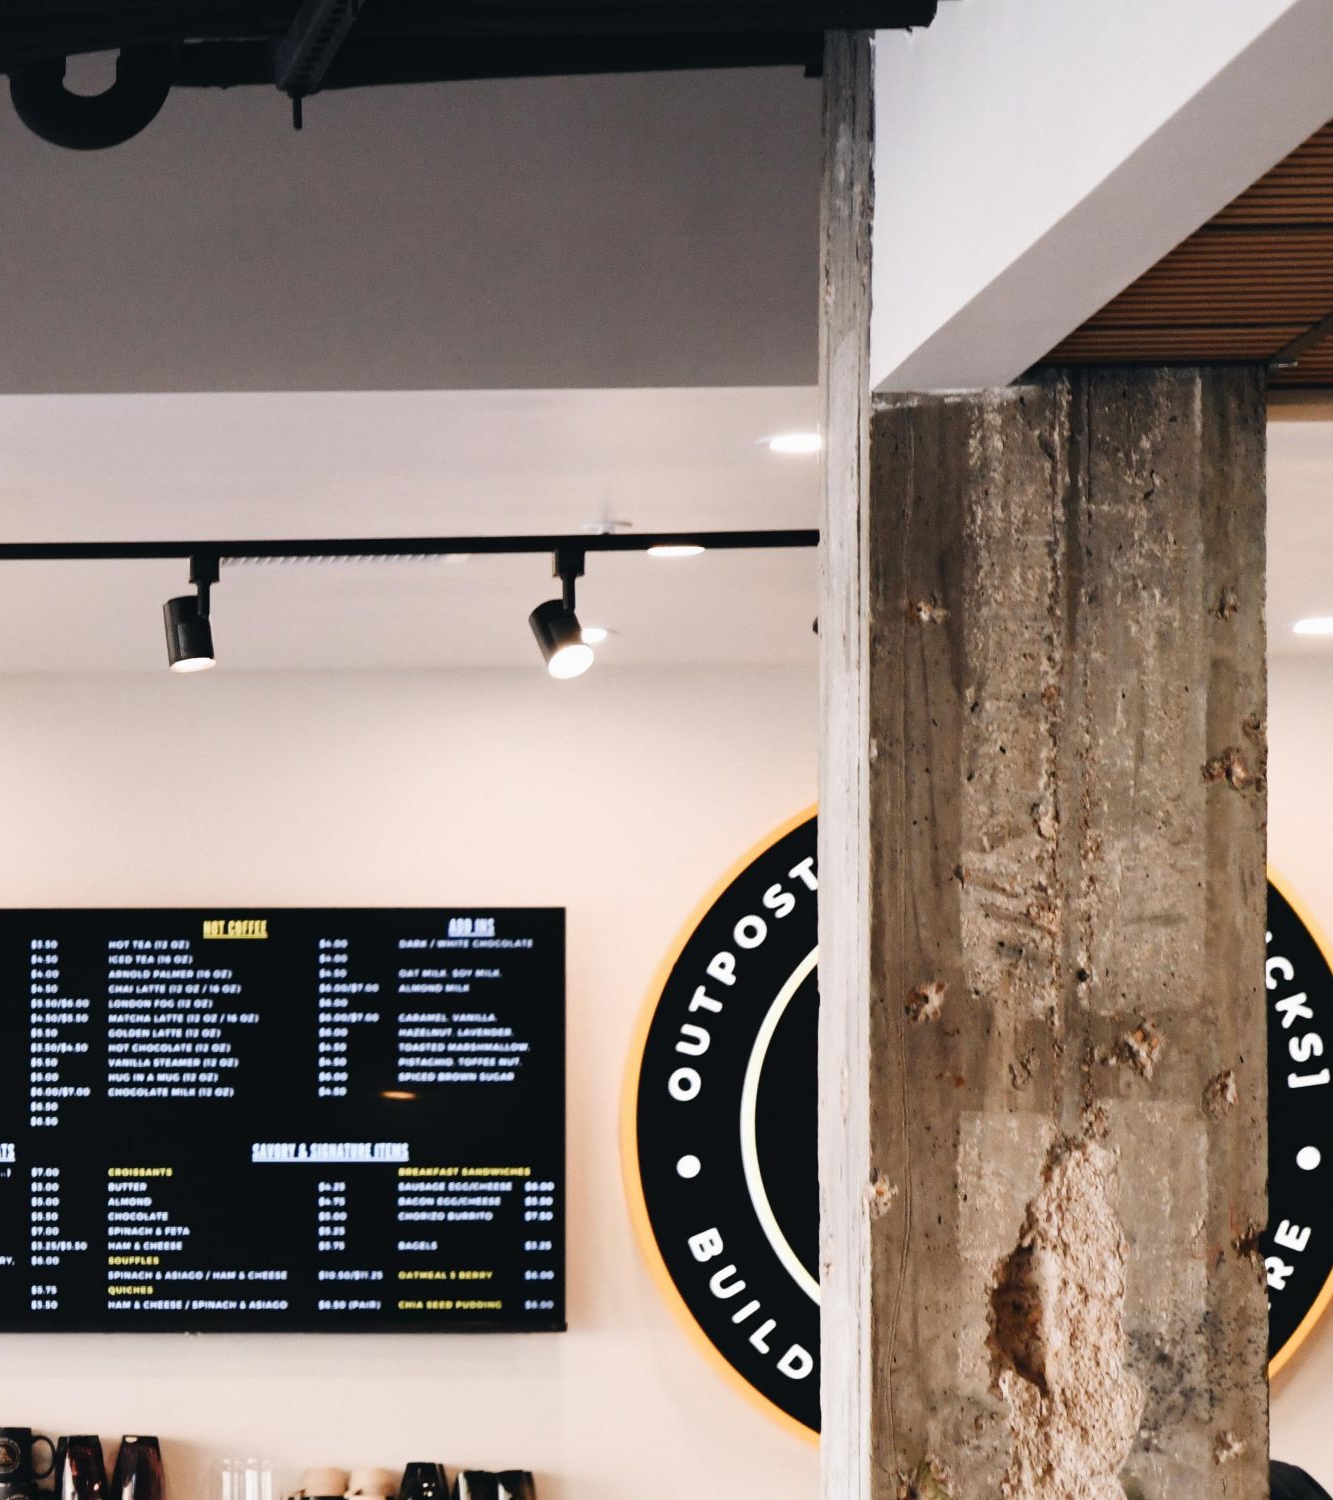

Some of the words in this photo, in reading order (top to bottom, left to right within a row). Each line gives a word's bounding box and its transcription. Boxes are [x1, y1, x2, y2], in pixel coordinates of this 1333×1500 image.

[203, 920, 225, 934] HOT
[227, 920, 267, 934] COFFEE
[668, 857, 818, 1101] OUTPOST
[108, 1167, 173, 1177] CROISSANTS
[107, 1182, 147, 1192] BUTTER
[107, 1196, 153, 1207] ALMOND
[107, 1211, 169, 1221] CHOCOLATE
[108, 1226, 153, 1236] SPINACH
[164, 1226, 190, 1236] FETA
[107, 1285, 153, 1296] QUICHES
[687, 1227, 814, 1380] BUILD
